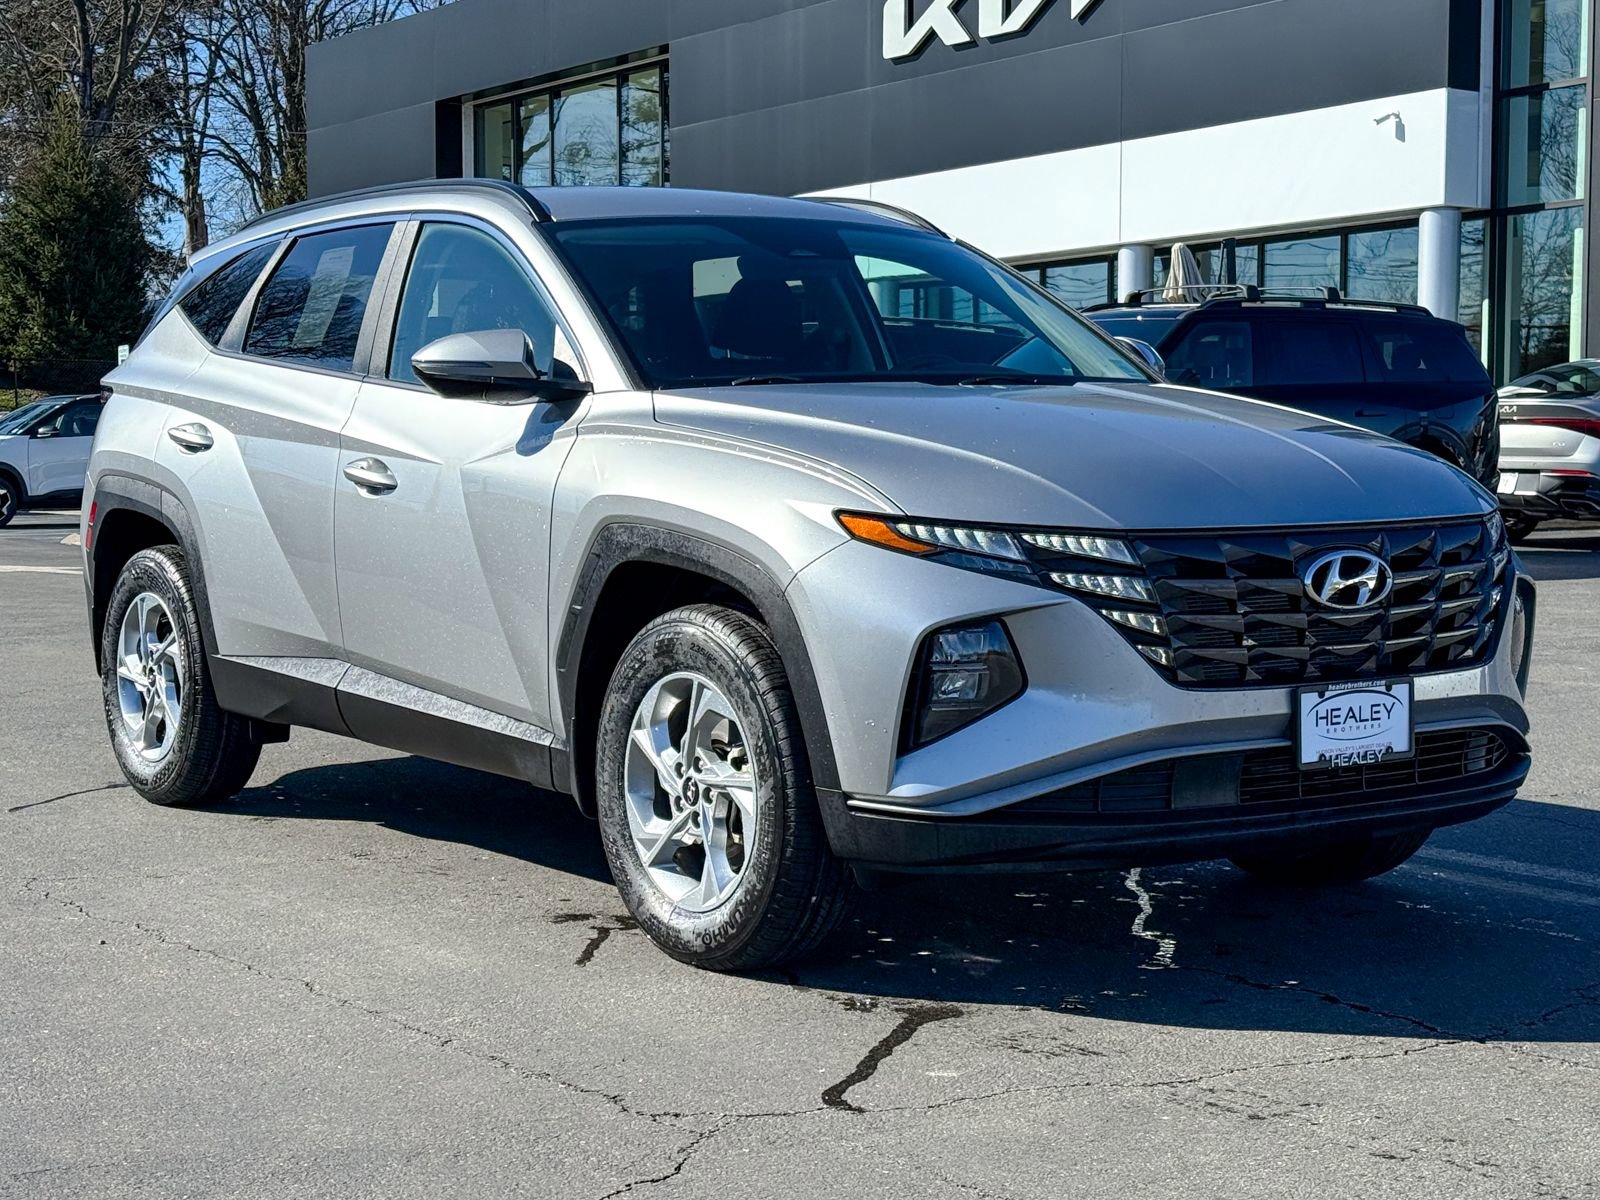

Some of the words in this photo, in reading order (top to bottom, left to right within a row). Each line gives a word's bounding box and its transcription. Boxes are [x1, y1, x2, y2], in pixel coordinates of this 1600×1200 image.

[1316, 702, 1395, 727] HEALEY
[1326, 723, 1382, 734] BROTHERS
[1331, 750, 1384, 768] HEALEY
